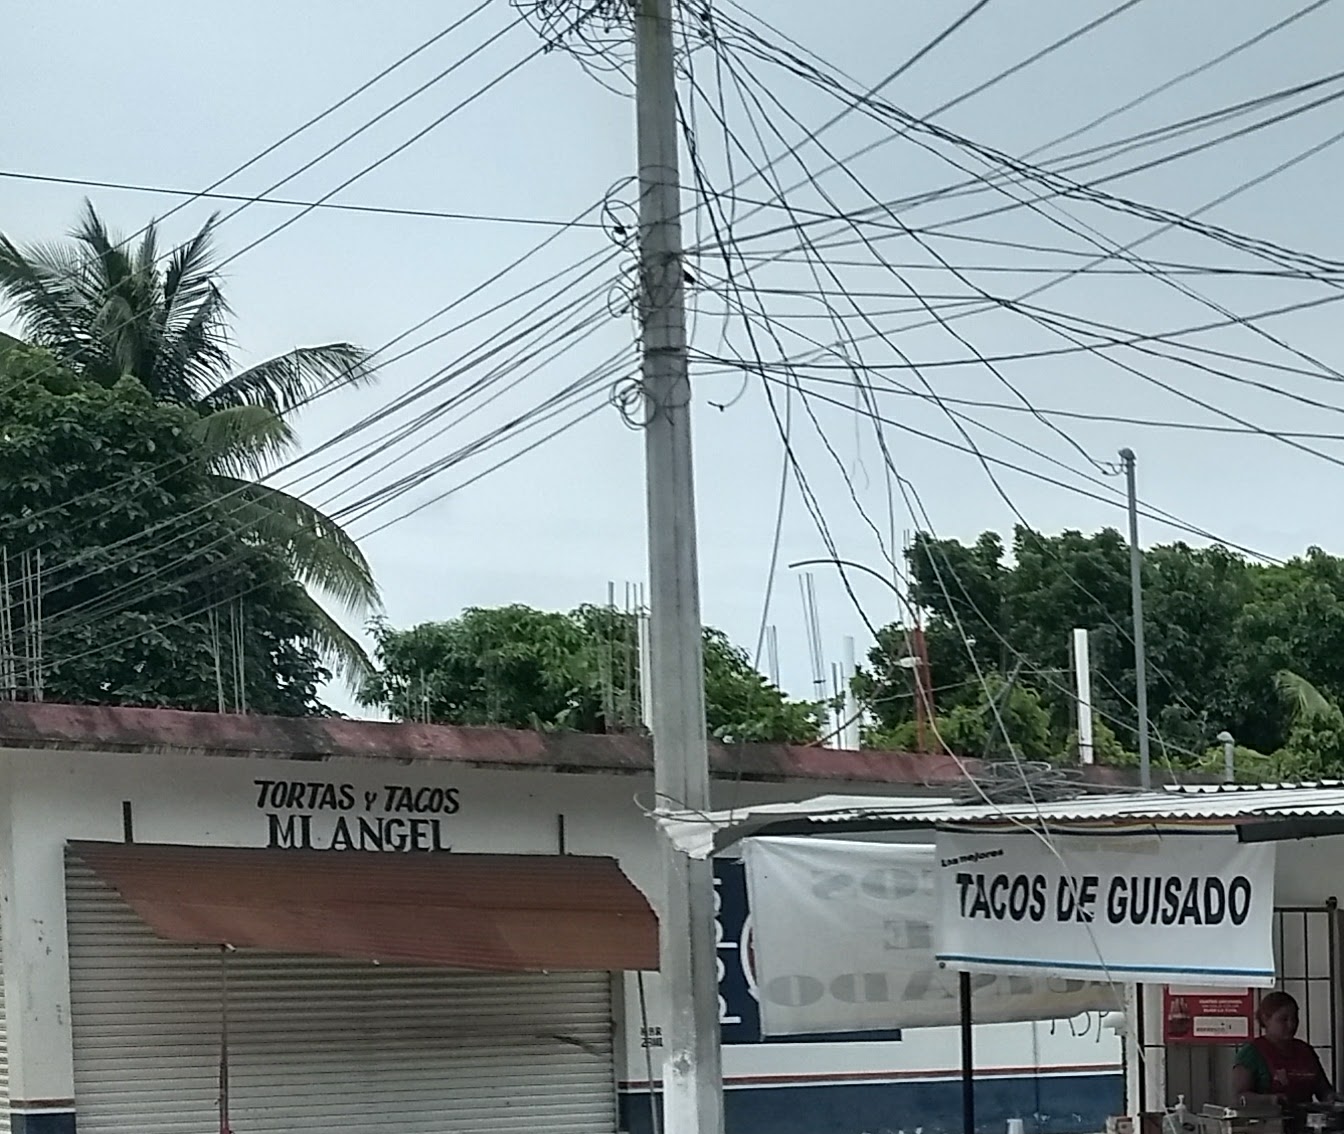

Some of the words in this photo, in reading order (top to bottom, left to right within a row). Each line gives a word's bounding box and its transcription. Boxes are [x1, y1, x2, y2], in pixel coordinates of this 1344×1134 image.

[254, 779, 355, 811] TORTAS
[384, 785, 460, 814] TACOS
[265, 813, 313, 849] MI
[329, 816, 451, 853] ANGEL
[955, 873, 1047, 923] TACOS
[1057, 875, 1099, 923] DE
[1107, 875, 1252, 926] GUISADO
